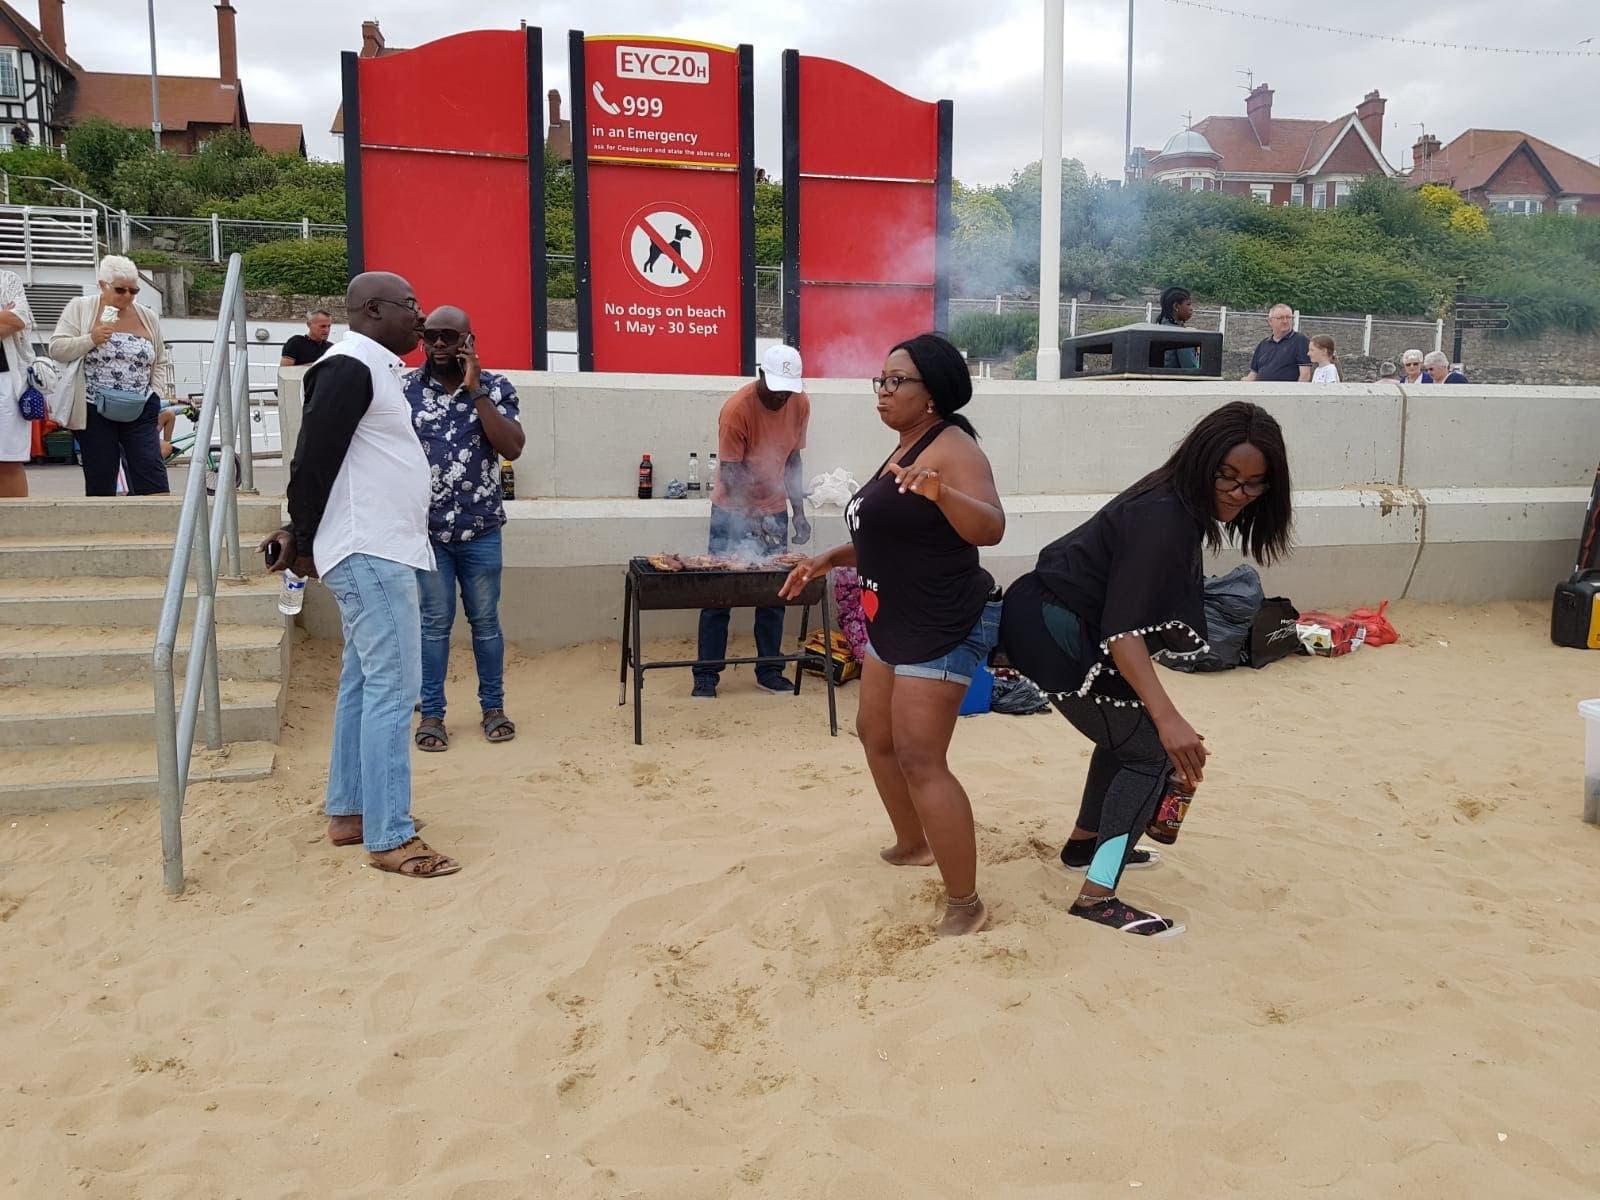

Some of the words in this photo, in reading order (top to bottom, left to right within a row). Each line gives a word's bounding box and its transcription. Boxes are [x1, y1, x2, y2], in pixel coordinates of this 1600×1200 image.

[622, 95, 664, 118] 999
[592, 124, 604, 137] in
[608, 128, 625, 138] an
[627, 127, 698, 145] Emergency
[617, 144, 653, 153] Coastguard
[654, 146, 666, 154] and
[667, 147, 683, 155] state
[684, 148, 695, 156] the
[696, 149, 715, 157] above
[715, 150, 731, 158] code
[604, 303, 625, 316] No
[628, 303, 662, 319] dogs
[665, 307, 683, 317] on
[687, 305, 726, 318] beach
[614, 320, 621, 332] 1
[626, 321, 656, 336] May
[668, 321, 685, 334] 30
[688, 322, 719, 337] Sept
